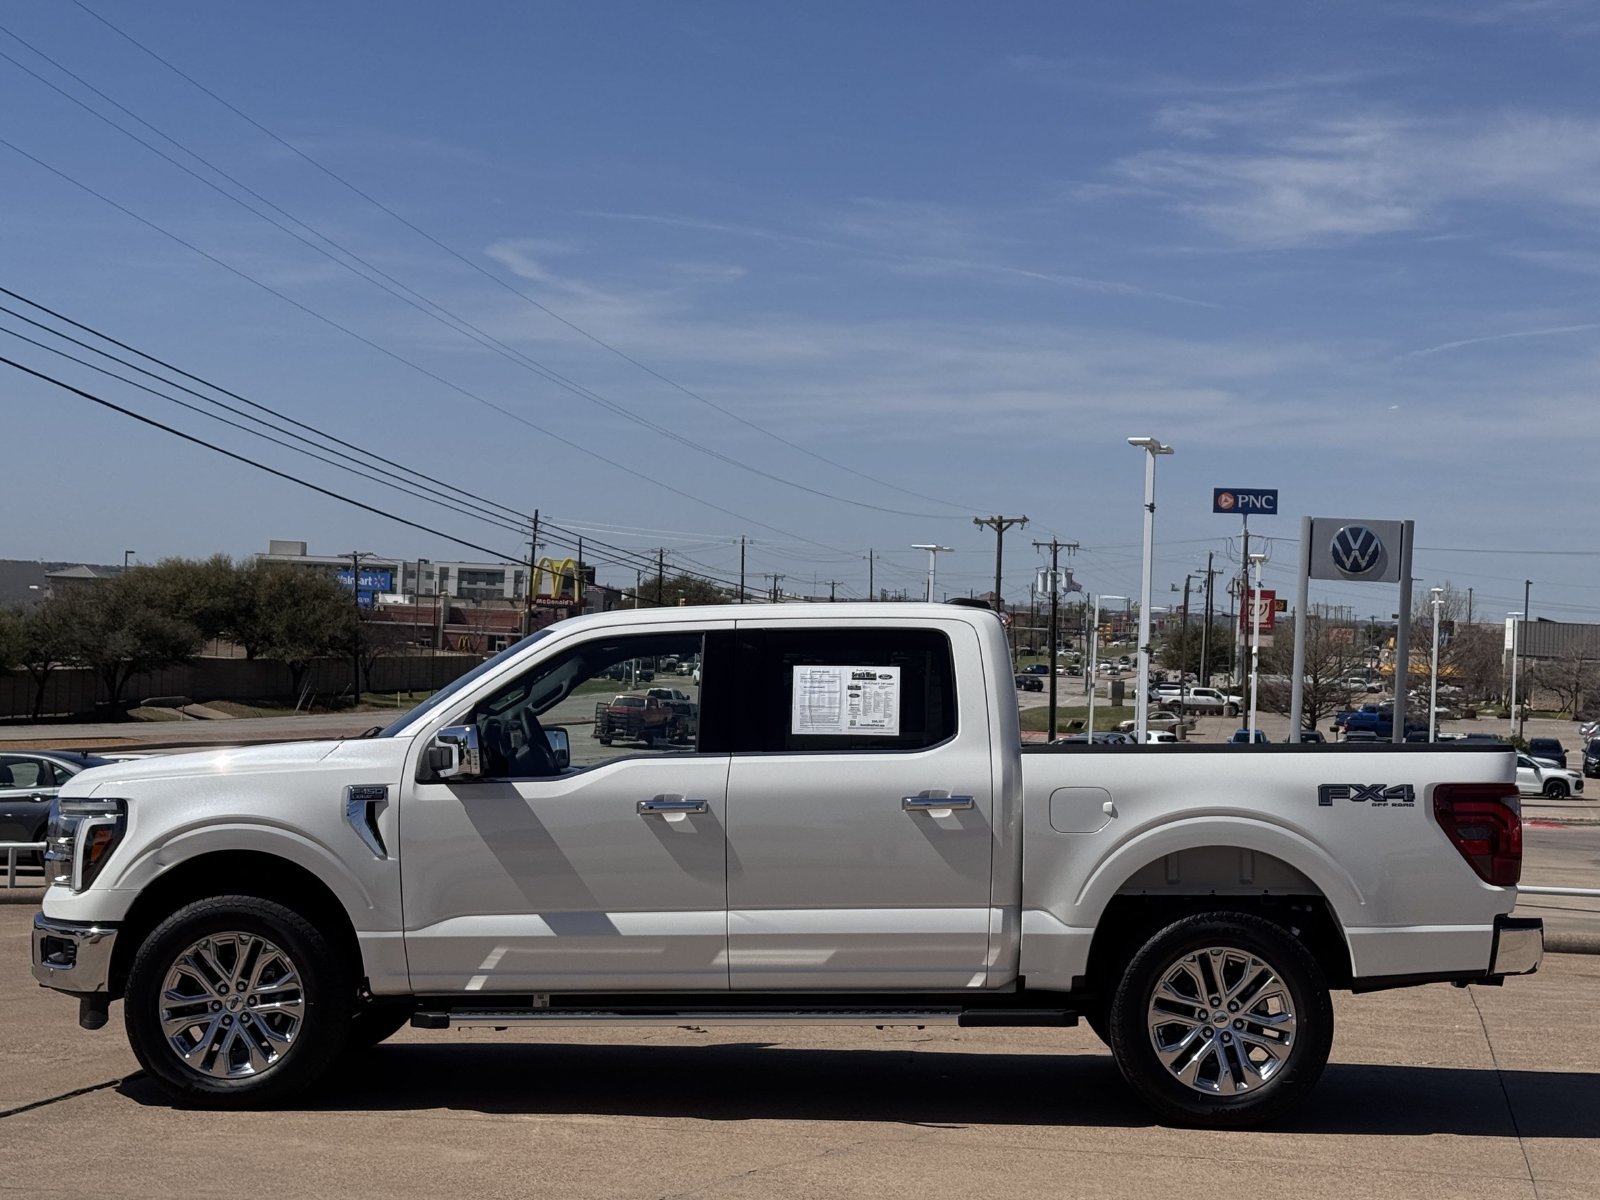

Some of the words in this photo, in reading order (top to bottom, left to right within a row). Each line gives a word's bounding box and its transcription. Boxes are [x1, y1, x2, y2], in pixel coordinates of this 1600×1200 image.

[1237, 494, 1274, 509] PNC
[536, 598, 574, 606] McDonald's
[1318, 783, 1415, 806] FX4
